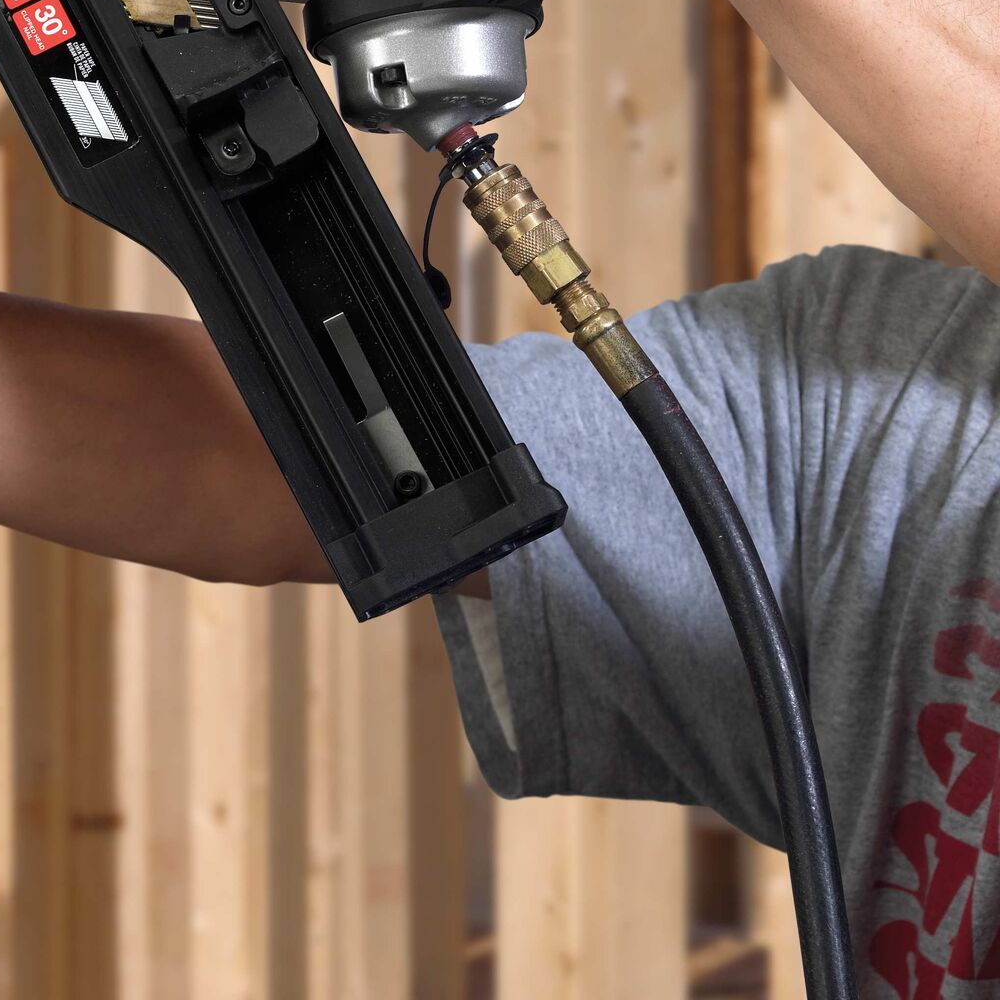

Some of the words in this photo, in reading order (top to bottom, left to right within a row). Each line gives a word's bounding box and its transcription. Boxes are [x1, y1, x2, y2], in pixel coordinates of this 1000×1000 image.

[20, 9, 37, 35] CLIPPED
[33, 34, 45, 51] HEAD
[23, 26, 32, 41] NAIL
